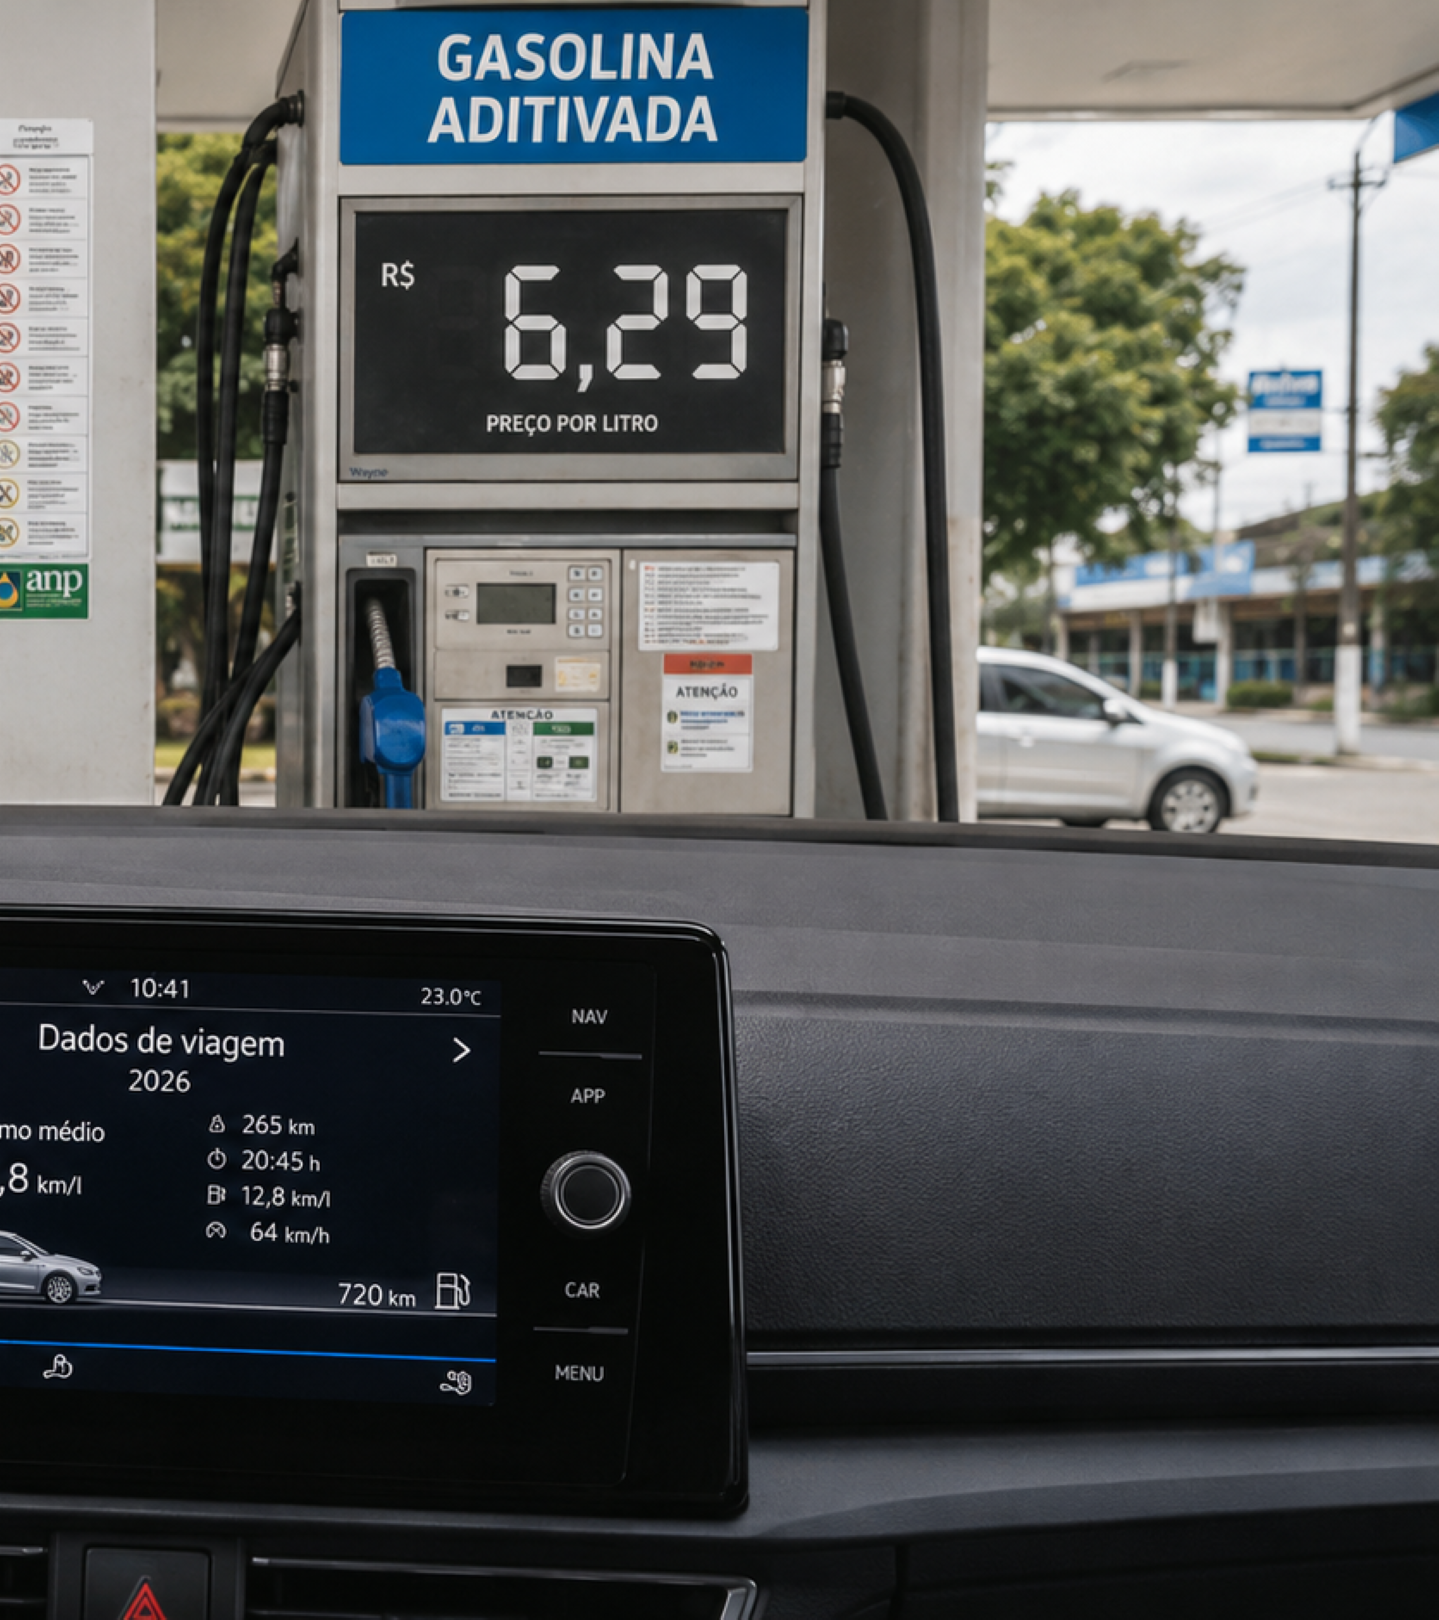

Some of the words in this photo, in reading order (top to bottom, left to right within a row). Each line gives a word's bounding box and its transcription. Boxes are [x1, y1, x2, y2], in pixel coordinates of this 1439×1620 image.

[437, 32, 715, 82] GASOLINA
[427, 95, 718, 144] ADITIVADA
[381, 260, 415, 290] R$
[504, 264, 748, 393] 6,29
[486, 414, 552, 438] PREÇO
[556, 414, 597, 433] POR
[602, 413, 659, 433] LITRO
[26, 569, 83, 598] anp
[676, 683, 738, 701] ATENÇÃO
[131, 977, 188, 999] 10:41
[420, 987, 481, 1006] 23.0°C
[572, 1008, 608, 1025] NAV
[39, 1023, 129, 1053] Dados
[137, 1025, 173, 1054] de
[180, 1027, 285, 1063] viagem
[128, 1068, 191, 1093] 2026
[570, 1087, 606, 1104] APP
[38, 1119, 106, 1143] médio
[242, 1114, 283, 1135] 265
[288, 1118, 315, 1135] km
[241, 1149, 304, 1172] 20:45
[309, 1154, 321, 1172] h
[37, 1174, 82, 1197] km/l
[241, 1185, 286, 1209] 12,8
[291, 1190, 331, 1209] km/l
[250, 1221, 278, 1242] 64
[284, 1226, 330, 1245] km/h
[338, 1282, 383, 1307] 720
[388, 1289, 417, 1308] km
[565, 1281, 600, 1299] CAR
[555, 1364, 605, 1383] MENU
